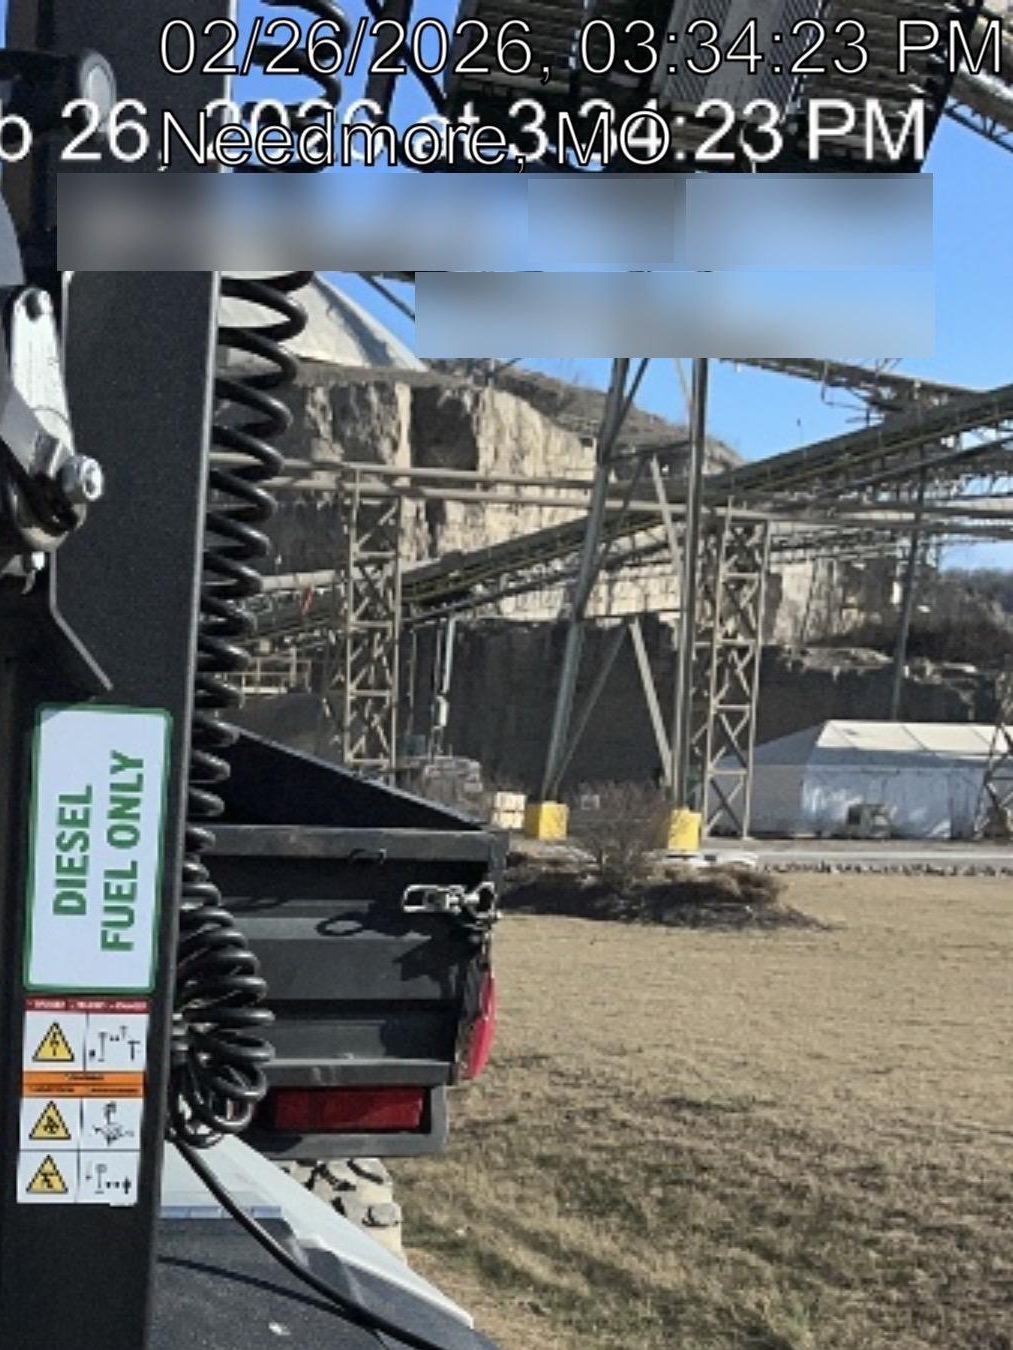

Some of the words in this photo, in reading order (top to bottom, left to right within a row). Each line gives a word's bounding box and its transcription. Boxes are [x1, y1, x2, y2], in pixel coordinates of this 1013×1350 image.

[52, 784, 94, 916] DIESEL
[106, 749, 145, 850] ONLY
[100, 859, 138, 951] FUEL
